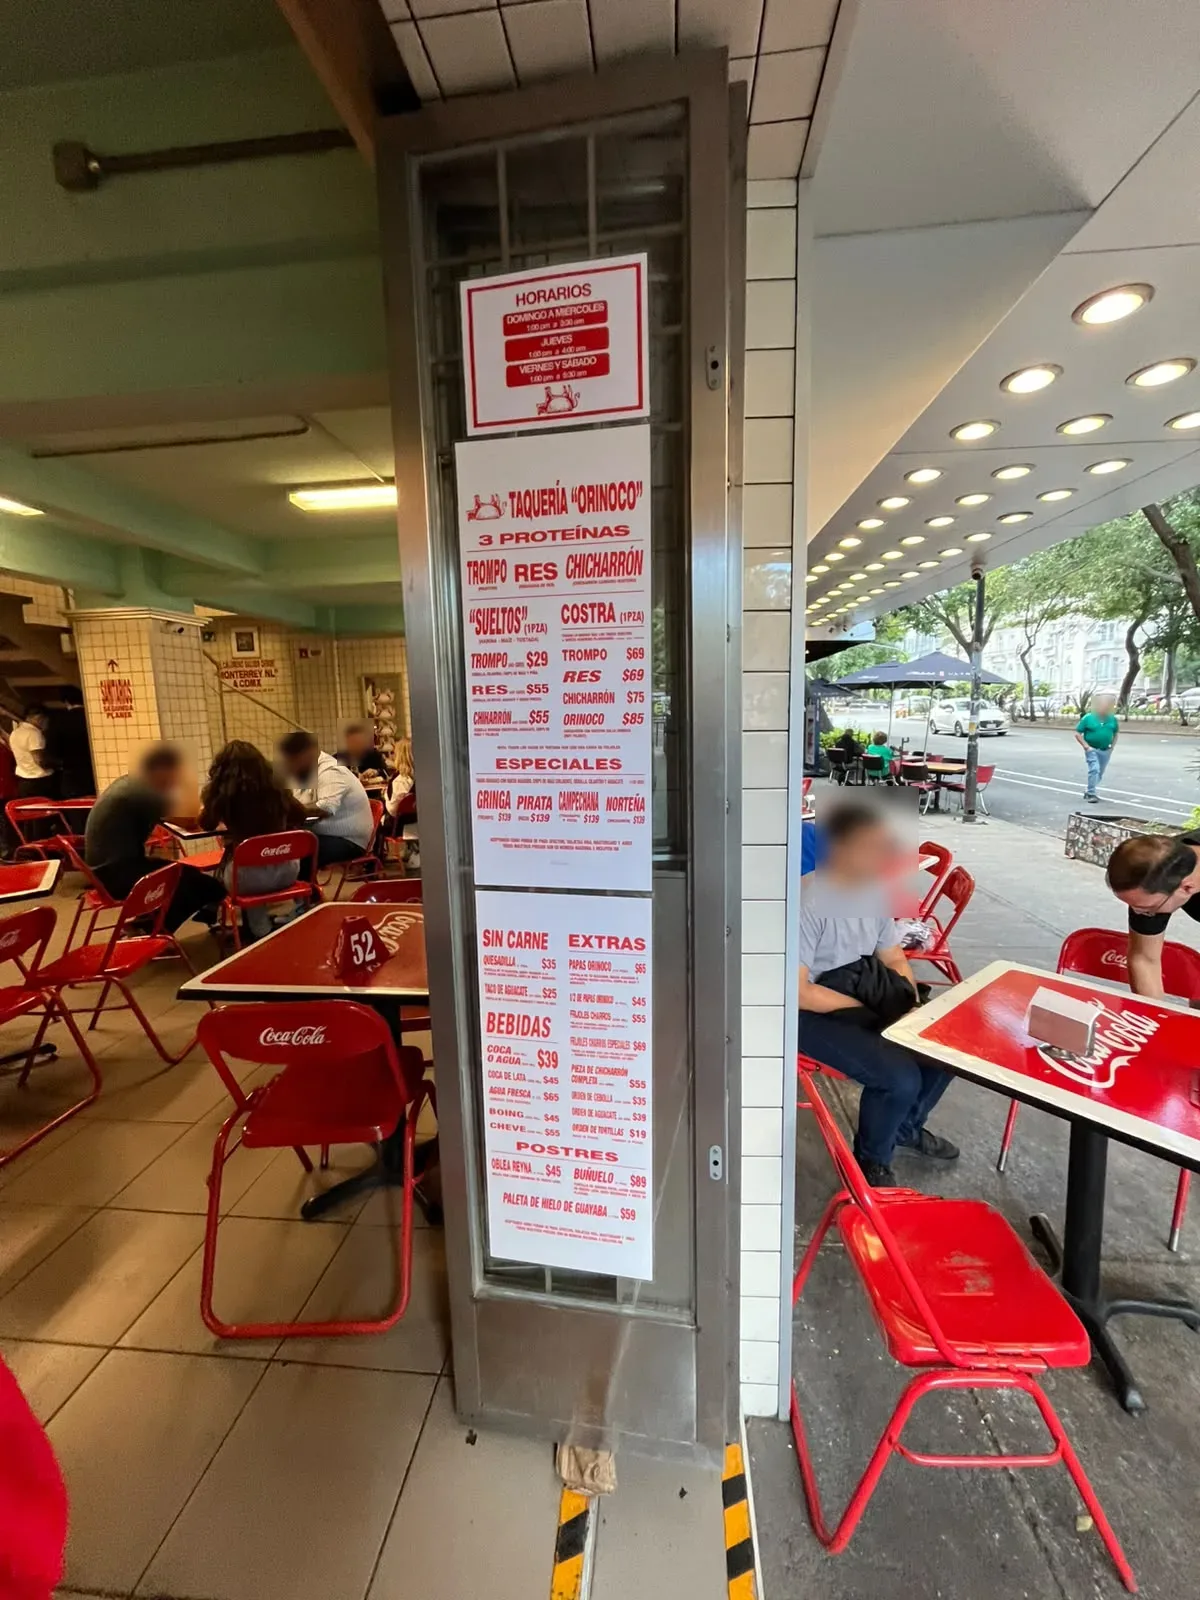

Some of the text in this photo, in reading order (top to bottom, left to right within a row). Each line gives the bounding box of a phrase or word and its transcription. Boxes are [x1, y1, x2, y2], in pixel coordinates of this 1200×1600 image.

[516, 283, 592, 307] HORARIOS
[507, 310, 547, 325] DOMINGO
[548, 309, 555, 319] A
[541, 334, 573, 348] JUEVES
[519, 362, 554, 375] VIERNES
[554, 360, 562, 370] Y
[508, 480, 568, 521] TAQUERÍA
[478, 525, 630, 546] 3 PROTEÍNAS
[467, 545, 644, 585] TROMPO RES CHICHARRÓN
[561, 602, 645, 625] COSTRA (1PZA)
[471, 650, 548, 669] TROMPO $29
[562, 647, 645, 661] TROMPO $69
[563, 668, 645, 683] RES $69
[472, 684, 508, 695] RES
[527, 684, 549, 695] $55
[563, 689, 645, 705] CHICHARRÓN $75
[529, 709, 550, 725] $55
[564, 712, 645, 726] ORINOCO $85
[496, 758, 622, 770] ESPECIALES
[477, 790, 645, 812] GRINGA PIRATA CAMPECHANA NORTEÑA
[530, 812, 550, 823] $139
[584, 814, 599, 824] $139
[350, 930, 376, 965] 52
[483, 929, 549, 950] SIN CARNE
[568, 934, 646, 951] EXTRAS
[483, 954, 556, 970] QUESADILLA $35
[569, 959, 586, 971] PAPAS
[542, 987, 557, 999] $25
[632, 996, 646, 1007] $45
[486, 1011, 551, 1038] BEBIDAS
[632, 1014, 646, 1024] $55
[259, 1026, 328, 1046] Coca-Cola
[487, 1044, 512, 1055] COCA
[487, 1054, 494, 1062] O
[496, 1055, 521, 1066] AGUA
[537, 1048, 559, 1069] $39
[488, 1070, 503, 1079] COCA
[504, 1071, 512, 1080] DE
[543, 1076, 559, 1085] $45
[629, 1078, 646, 1089] $55
[489, 1086, 506, 1096] AGUA
[507, 1087, 531, 1099] FRESCA
[543, 1091, 559, 1102] $65
[632, 1096, 646, 1106] $35
[489, 1107, 560, 1123] BOING $45
[632, 1112, 647, 1122] $39
[490, 1122, 560, 1137] CHEVE $55
[629, 1128, 647, 1139] $19
[516, 1141, 619, 1162] POSTRES
[491, 1158, 510, 1171] OBLEA
[512, 1159, 532, 1174] REYNA
[545, 1163, 561, 1178] $45
[573, 1167, 614, 1184] BUÑUELO
[630, 1174, 647, 1188] $89
[503, 1192, 636, 1221] PALETA DE HIELO DE GUAYABA $59
